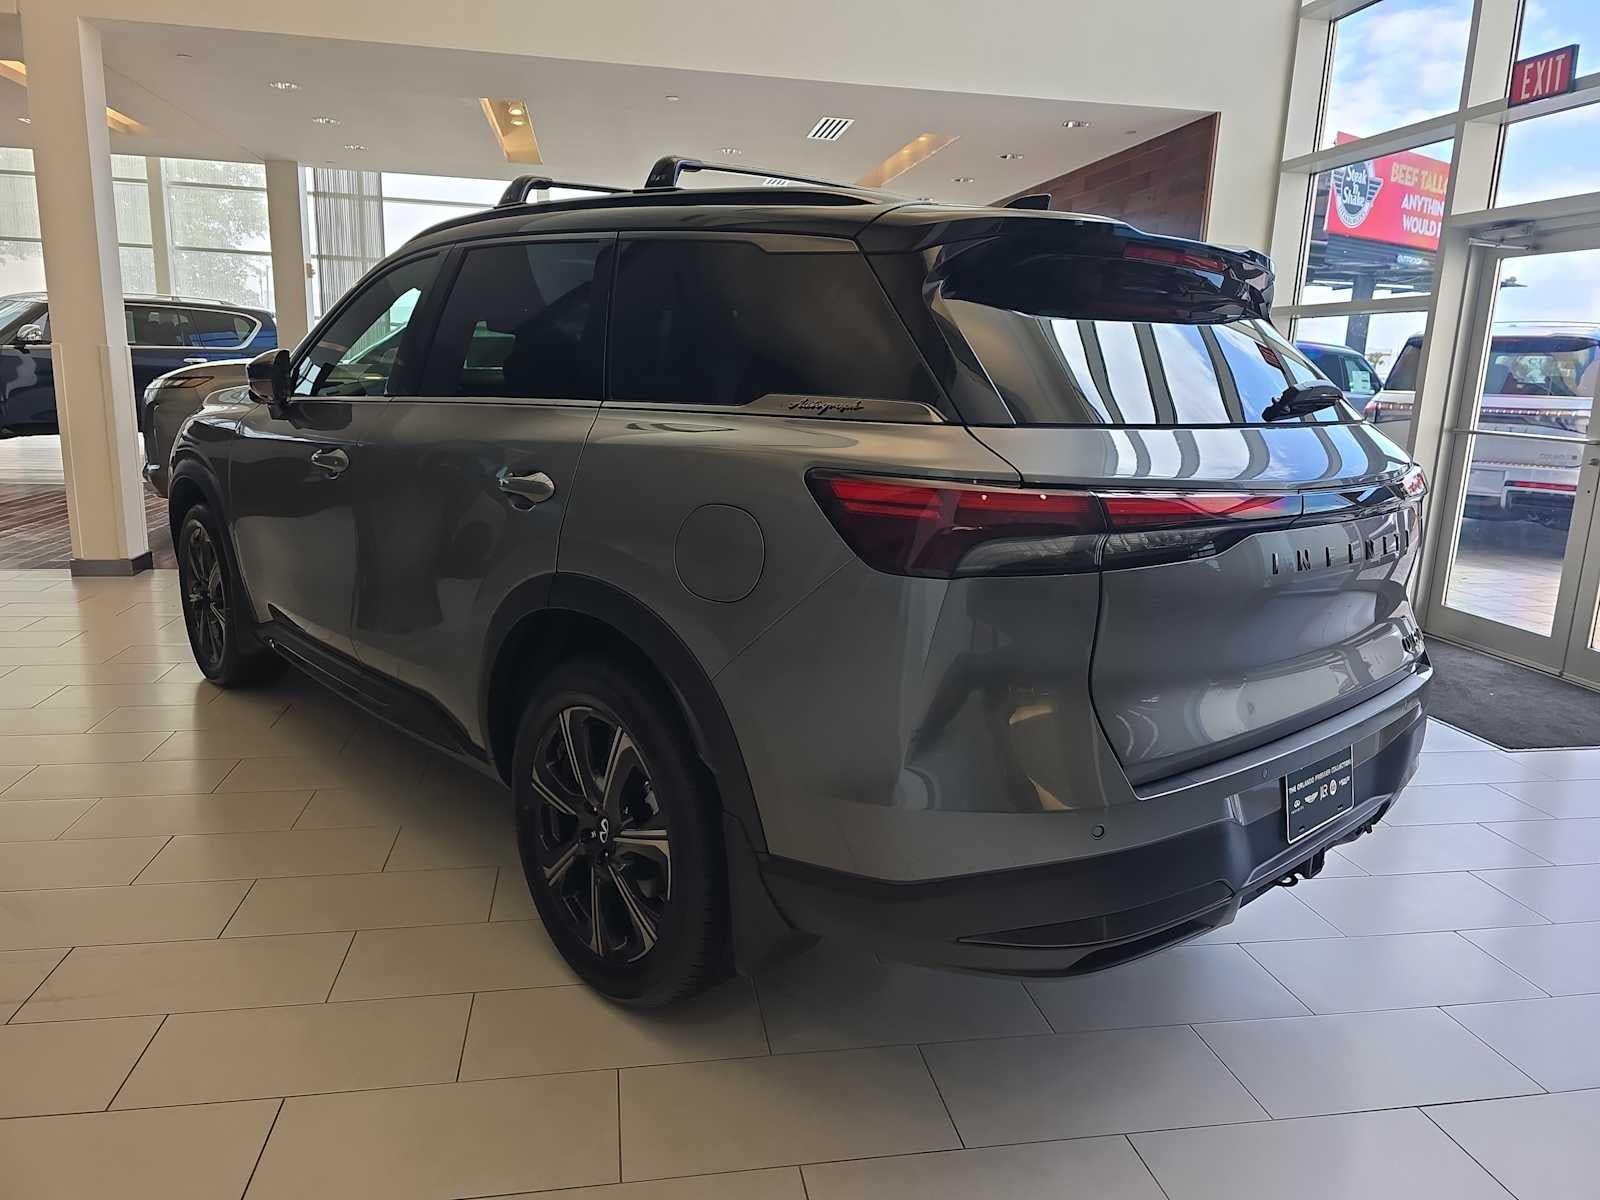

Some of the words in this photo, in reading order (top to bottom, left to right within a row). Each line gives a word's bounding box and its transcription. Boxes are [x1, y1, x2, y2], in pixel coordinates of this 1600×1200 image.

[1521, 54, 1566, 100] EXIT
[1346, 165, 1368, 185] Steak
[1391, 162, 1418, 187] BEEF
[1343, 187, 1366, 206] Shake
[1403, 215, 1437, 237] WOULD
[1272, 530, 1409, 575] INFINITI
[1288, 785, 1297, 794] THE
[1296, 776, 1315, 790] ORLANDO
